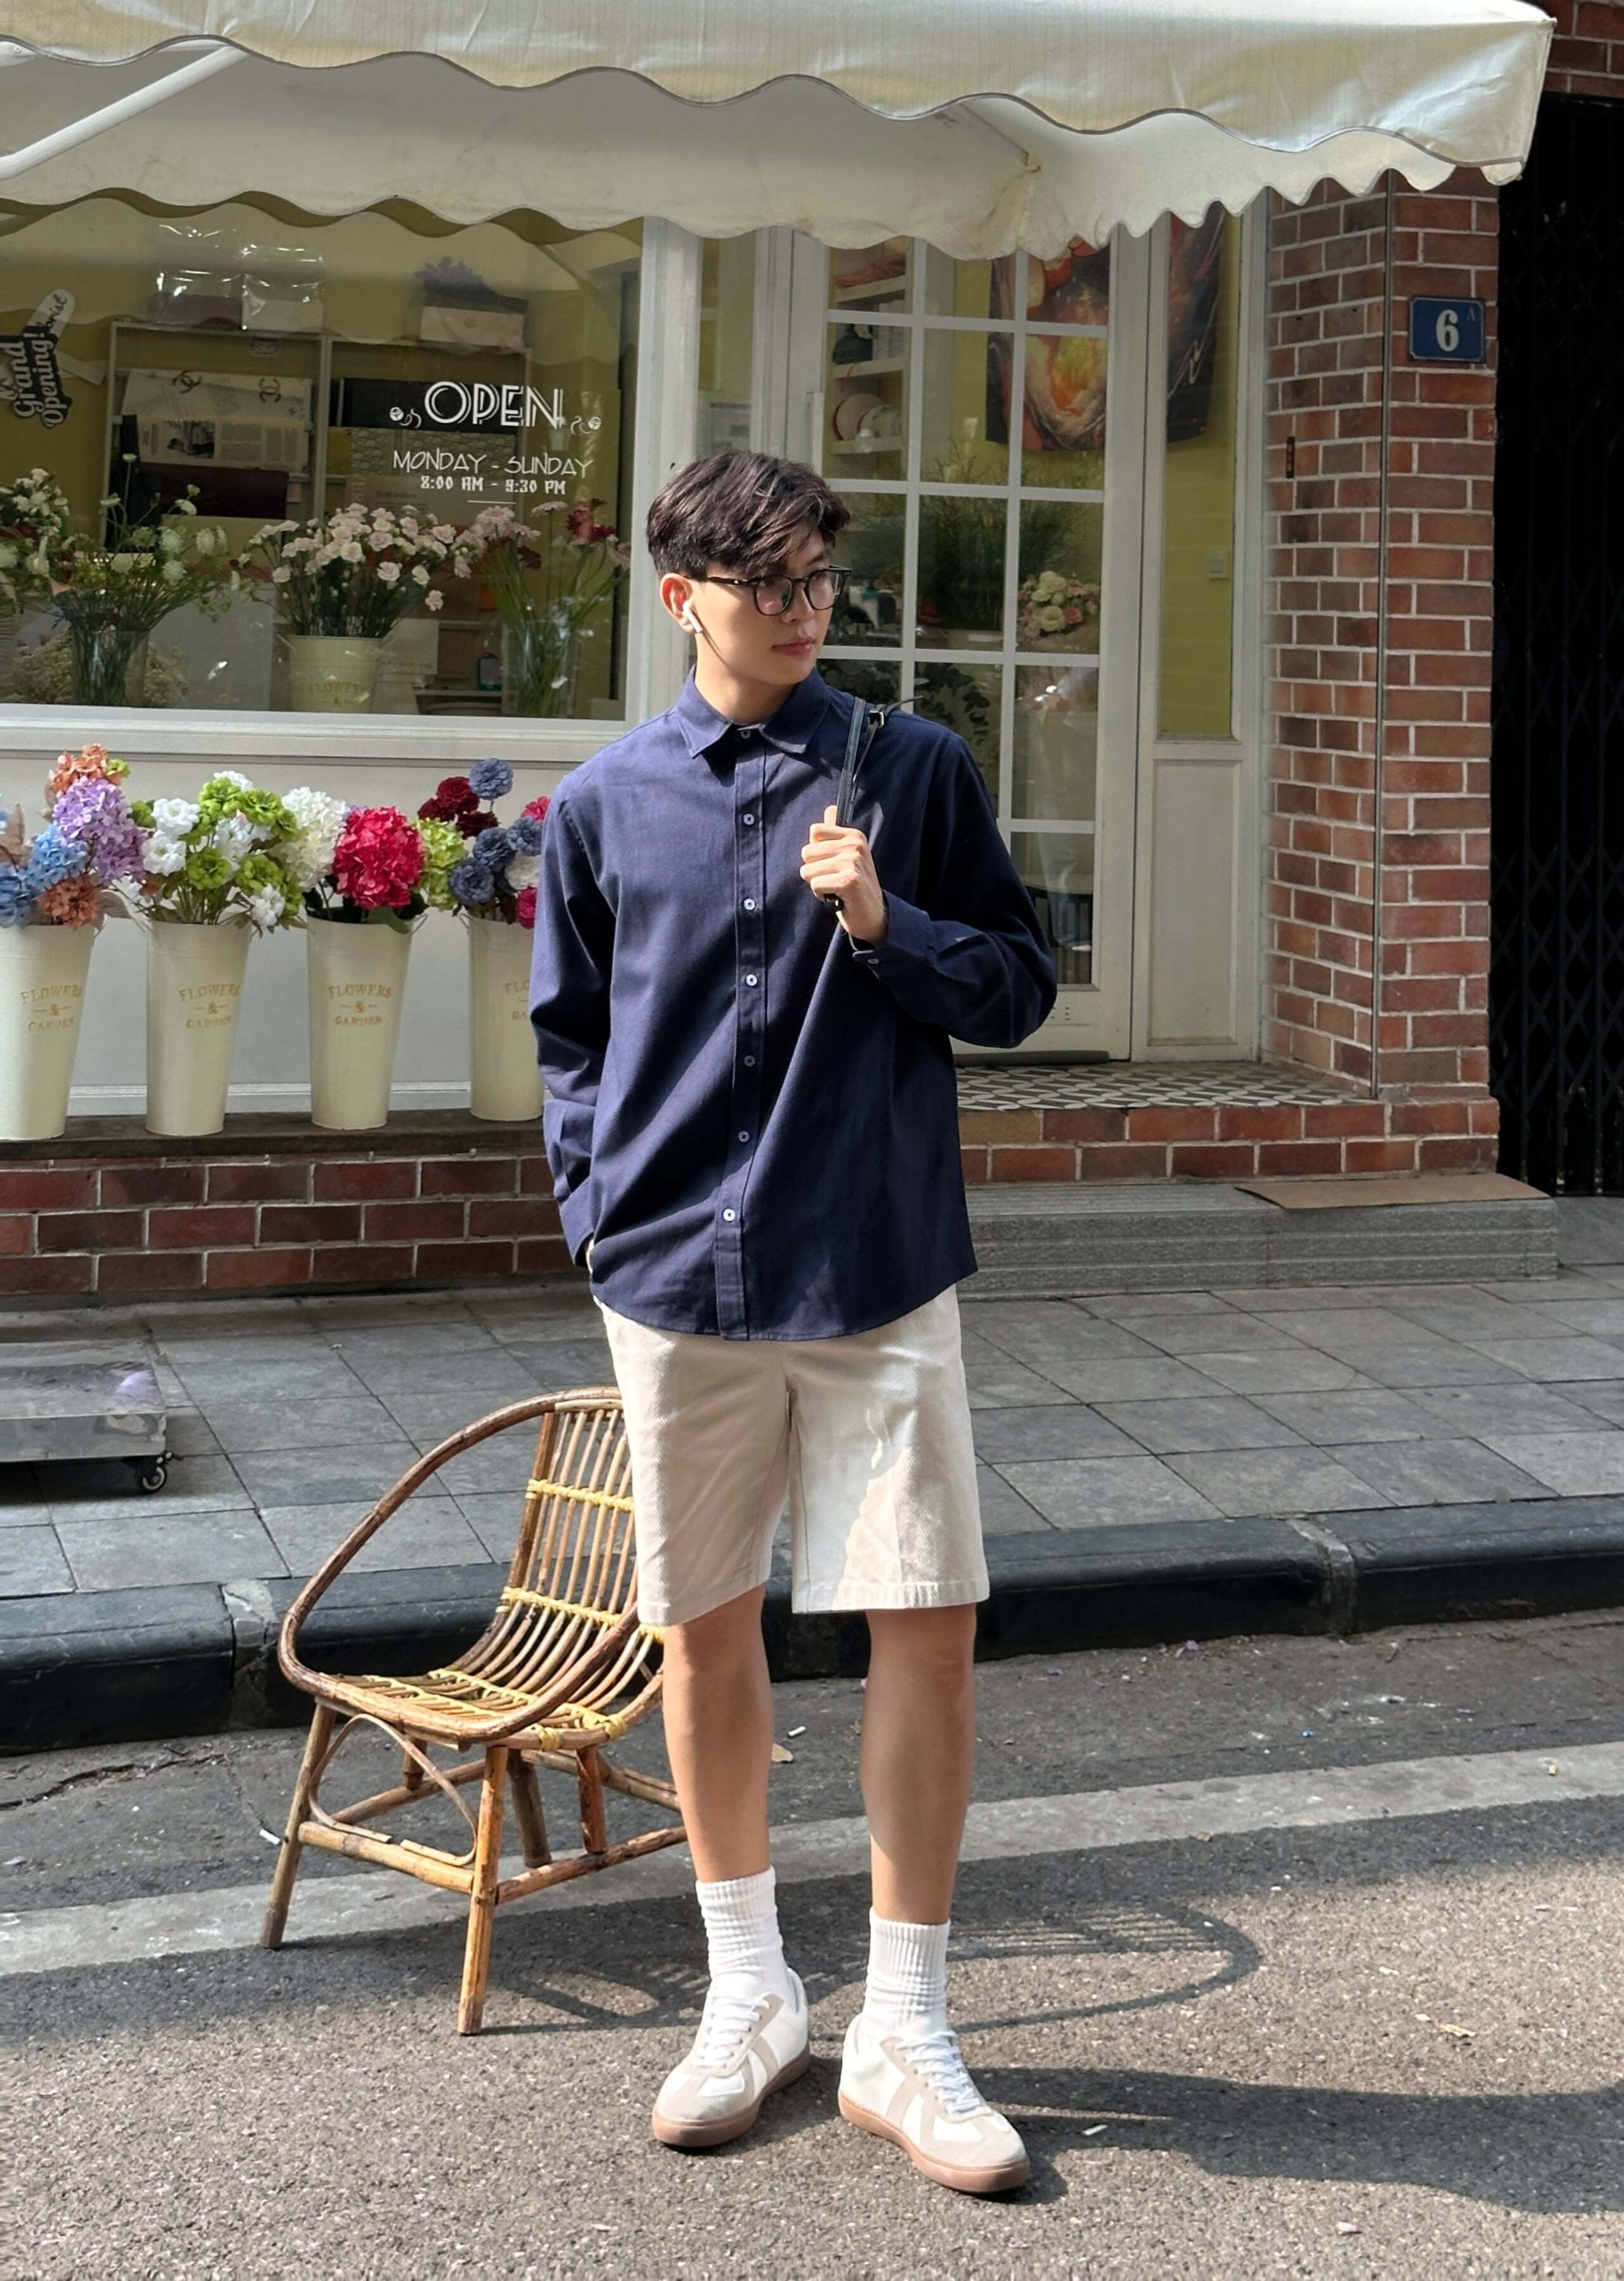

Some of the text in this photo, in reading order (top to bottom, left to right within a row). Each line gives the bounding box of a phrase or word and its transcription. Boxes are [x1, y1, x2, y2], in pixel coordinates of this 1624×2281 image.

[1436, 309, 1459, 352] 6
[0, 341, 44, 417] Grand
[23, 333, 67, 427] Opening!
[425, 381, 563, 429] OPEN
[393, 448, 487, 473] MONDAY
[504, 453, 594, 478] SUNDAY
[421, 476, 454, 489] 8:00
[461, 477, 483, 492] AM
[505, 479, 537, 493] 9:30
[545, 480, 566, 494] PM
[328, 984, 392, 999] FLOWERS
[334, 1015, 383, 1025] GARDEN
